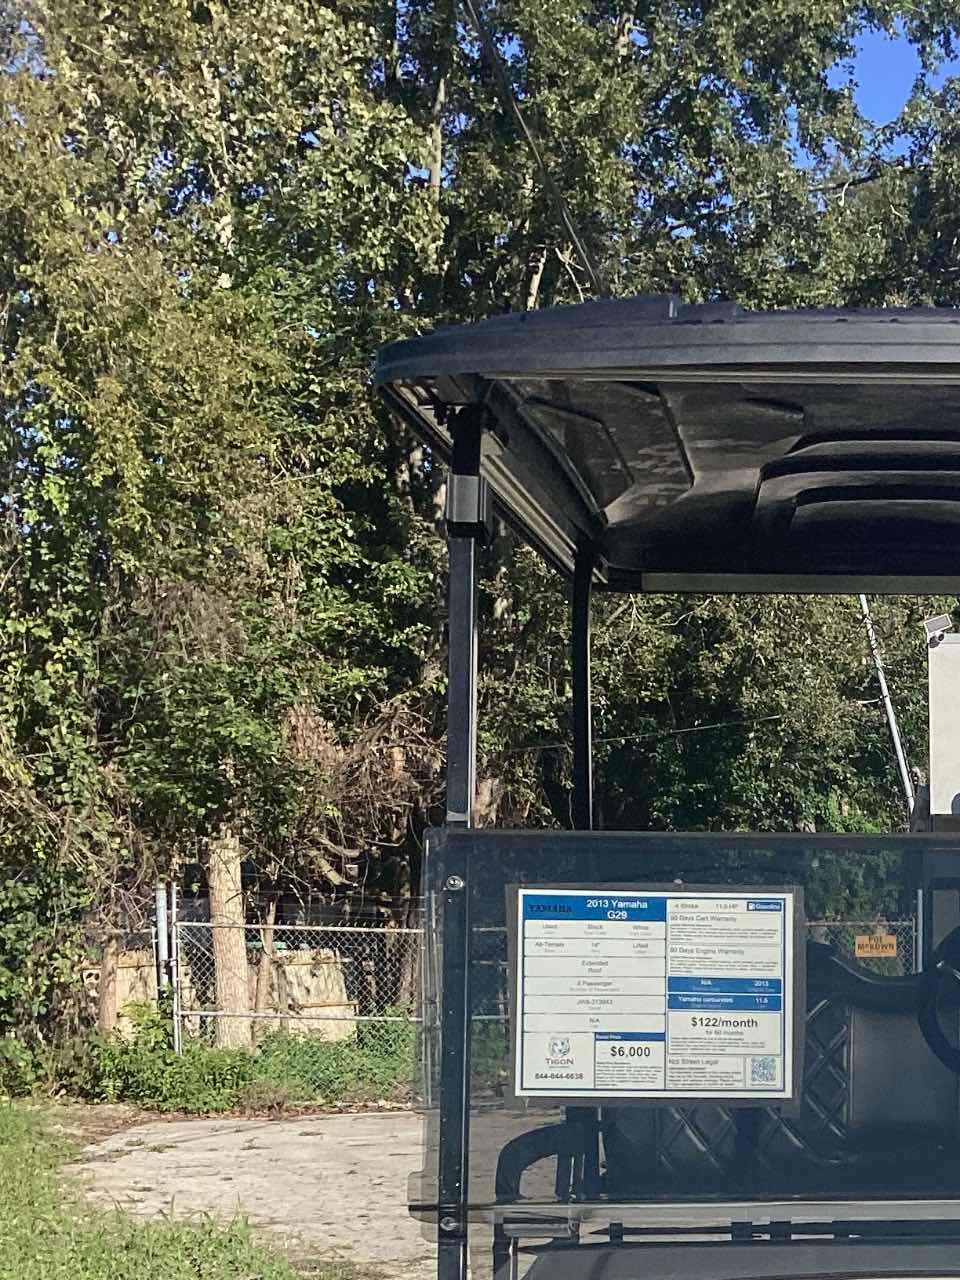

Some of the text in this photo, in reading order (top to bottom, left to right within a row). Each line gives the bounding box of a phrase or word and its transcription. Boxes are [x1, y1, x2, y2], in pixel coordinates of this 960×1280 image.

[586, 899, 648, 909] 2013 Yamaha
[607, 910, 628, 920] G29
[690, 1016, 759, 1028] $122/month
[610, 1045, 651, 1058] $6,000
